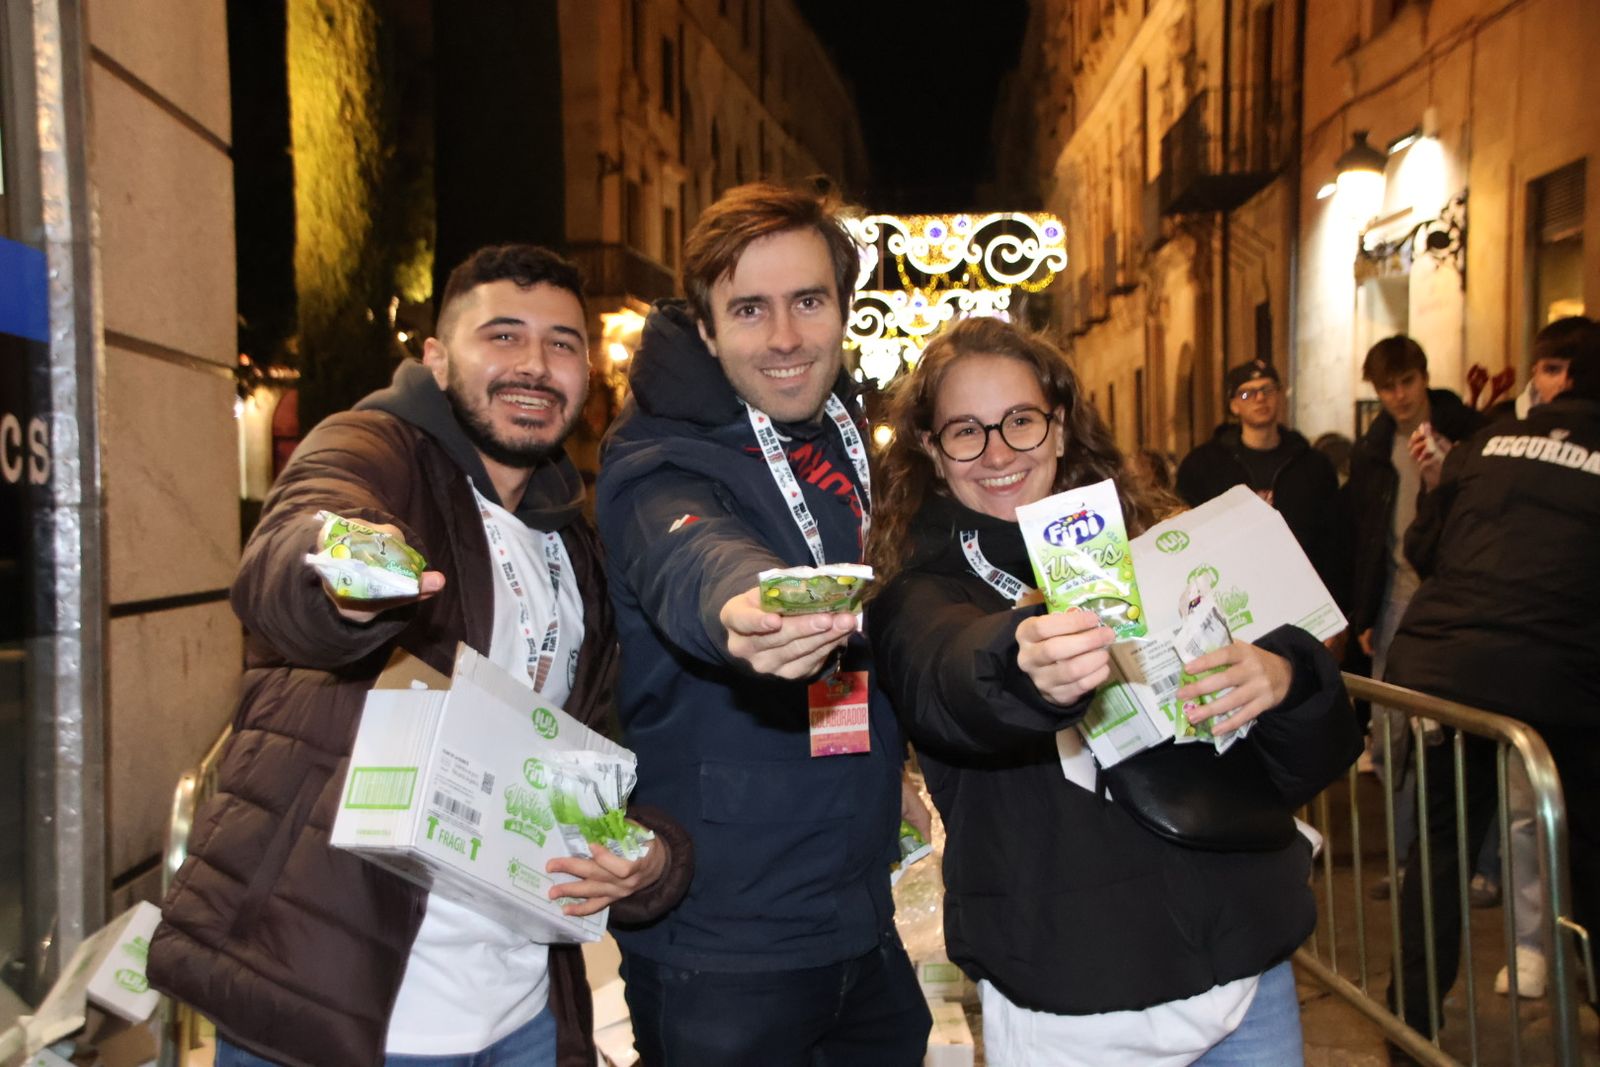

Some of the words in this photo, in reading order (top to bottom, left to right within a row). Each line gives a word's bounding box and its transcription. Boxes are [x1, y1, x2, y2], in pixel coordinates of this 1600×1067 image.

[0, 413, 50, 484] CS
[1048, 510, 1101, 546] Fini
[1005, 577, 1022, 590] COPEO
[1007, 586, 1018, 596] VIDA
[439, 827, 466, 854] FRÁGIL
